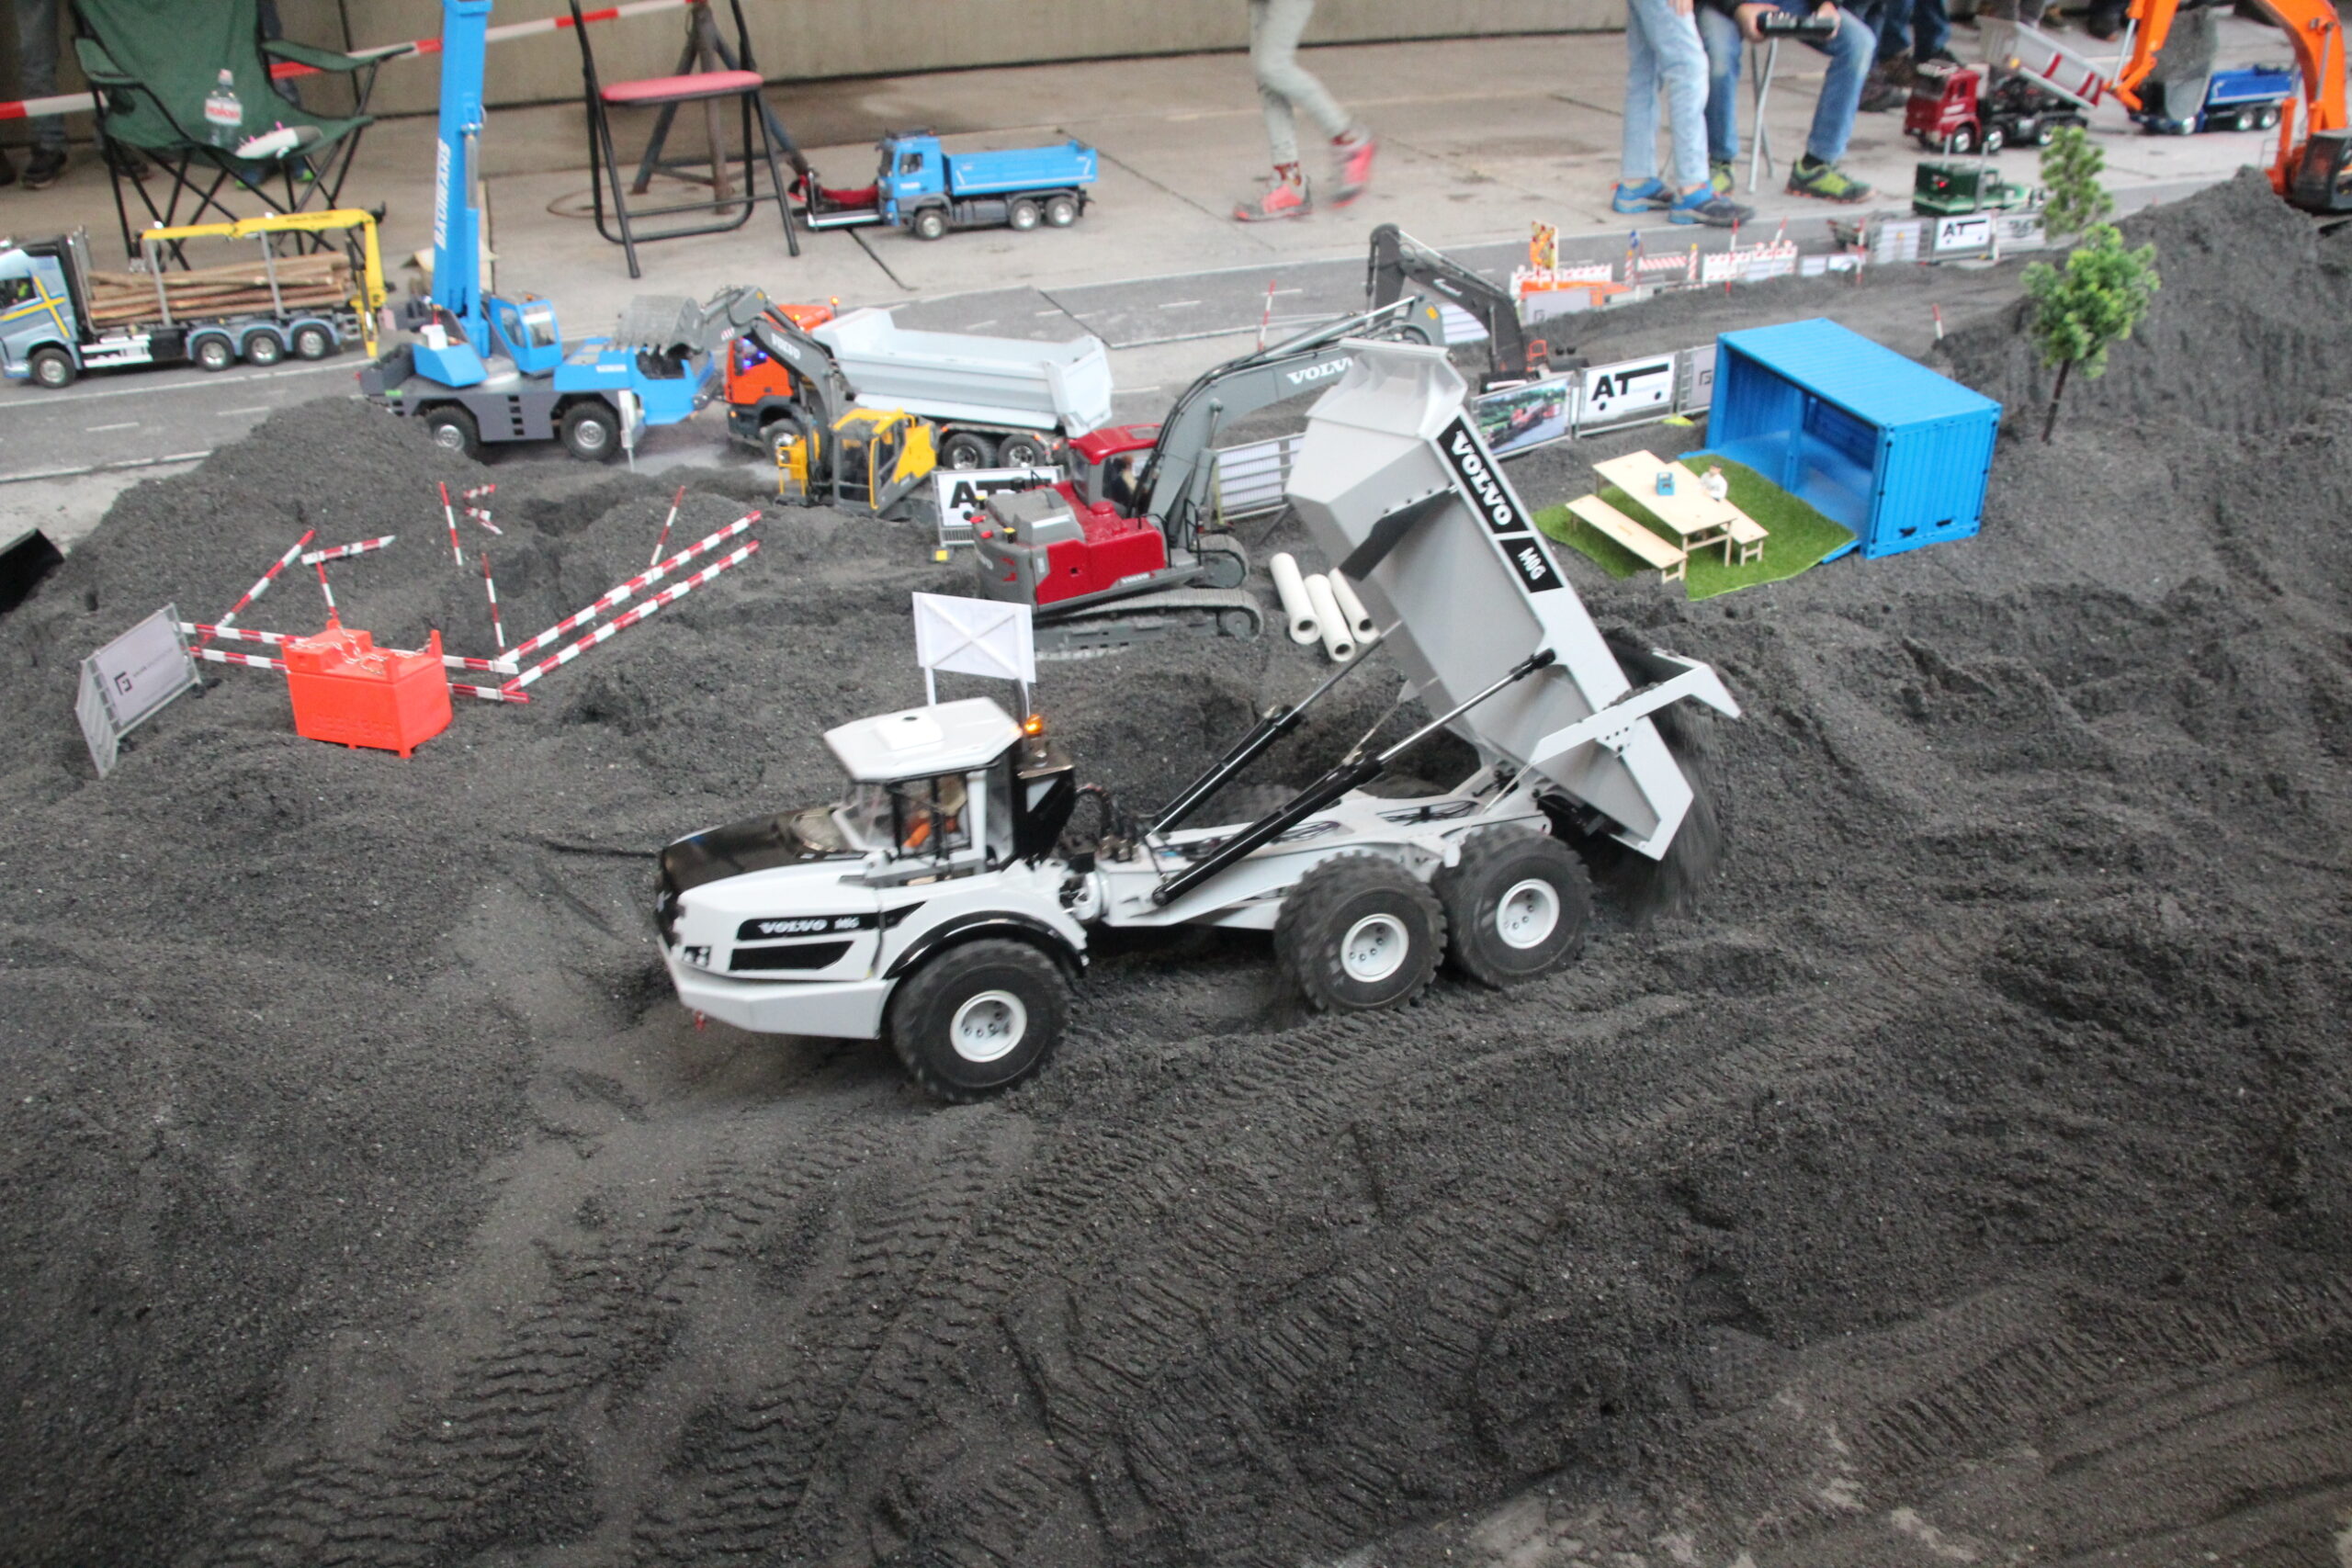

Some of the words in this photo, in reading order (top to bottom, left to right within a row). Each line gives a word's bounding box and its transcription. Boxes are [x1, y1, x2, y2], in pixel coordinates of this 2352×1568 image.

[1591, 363, 1669, 401] AT
[1452, 429, 1512, 525] VOLVO
[758, 919, 828, 934] VOLVO
